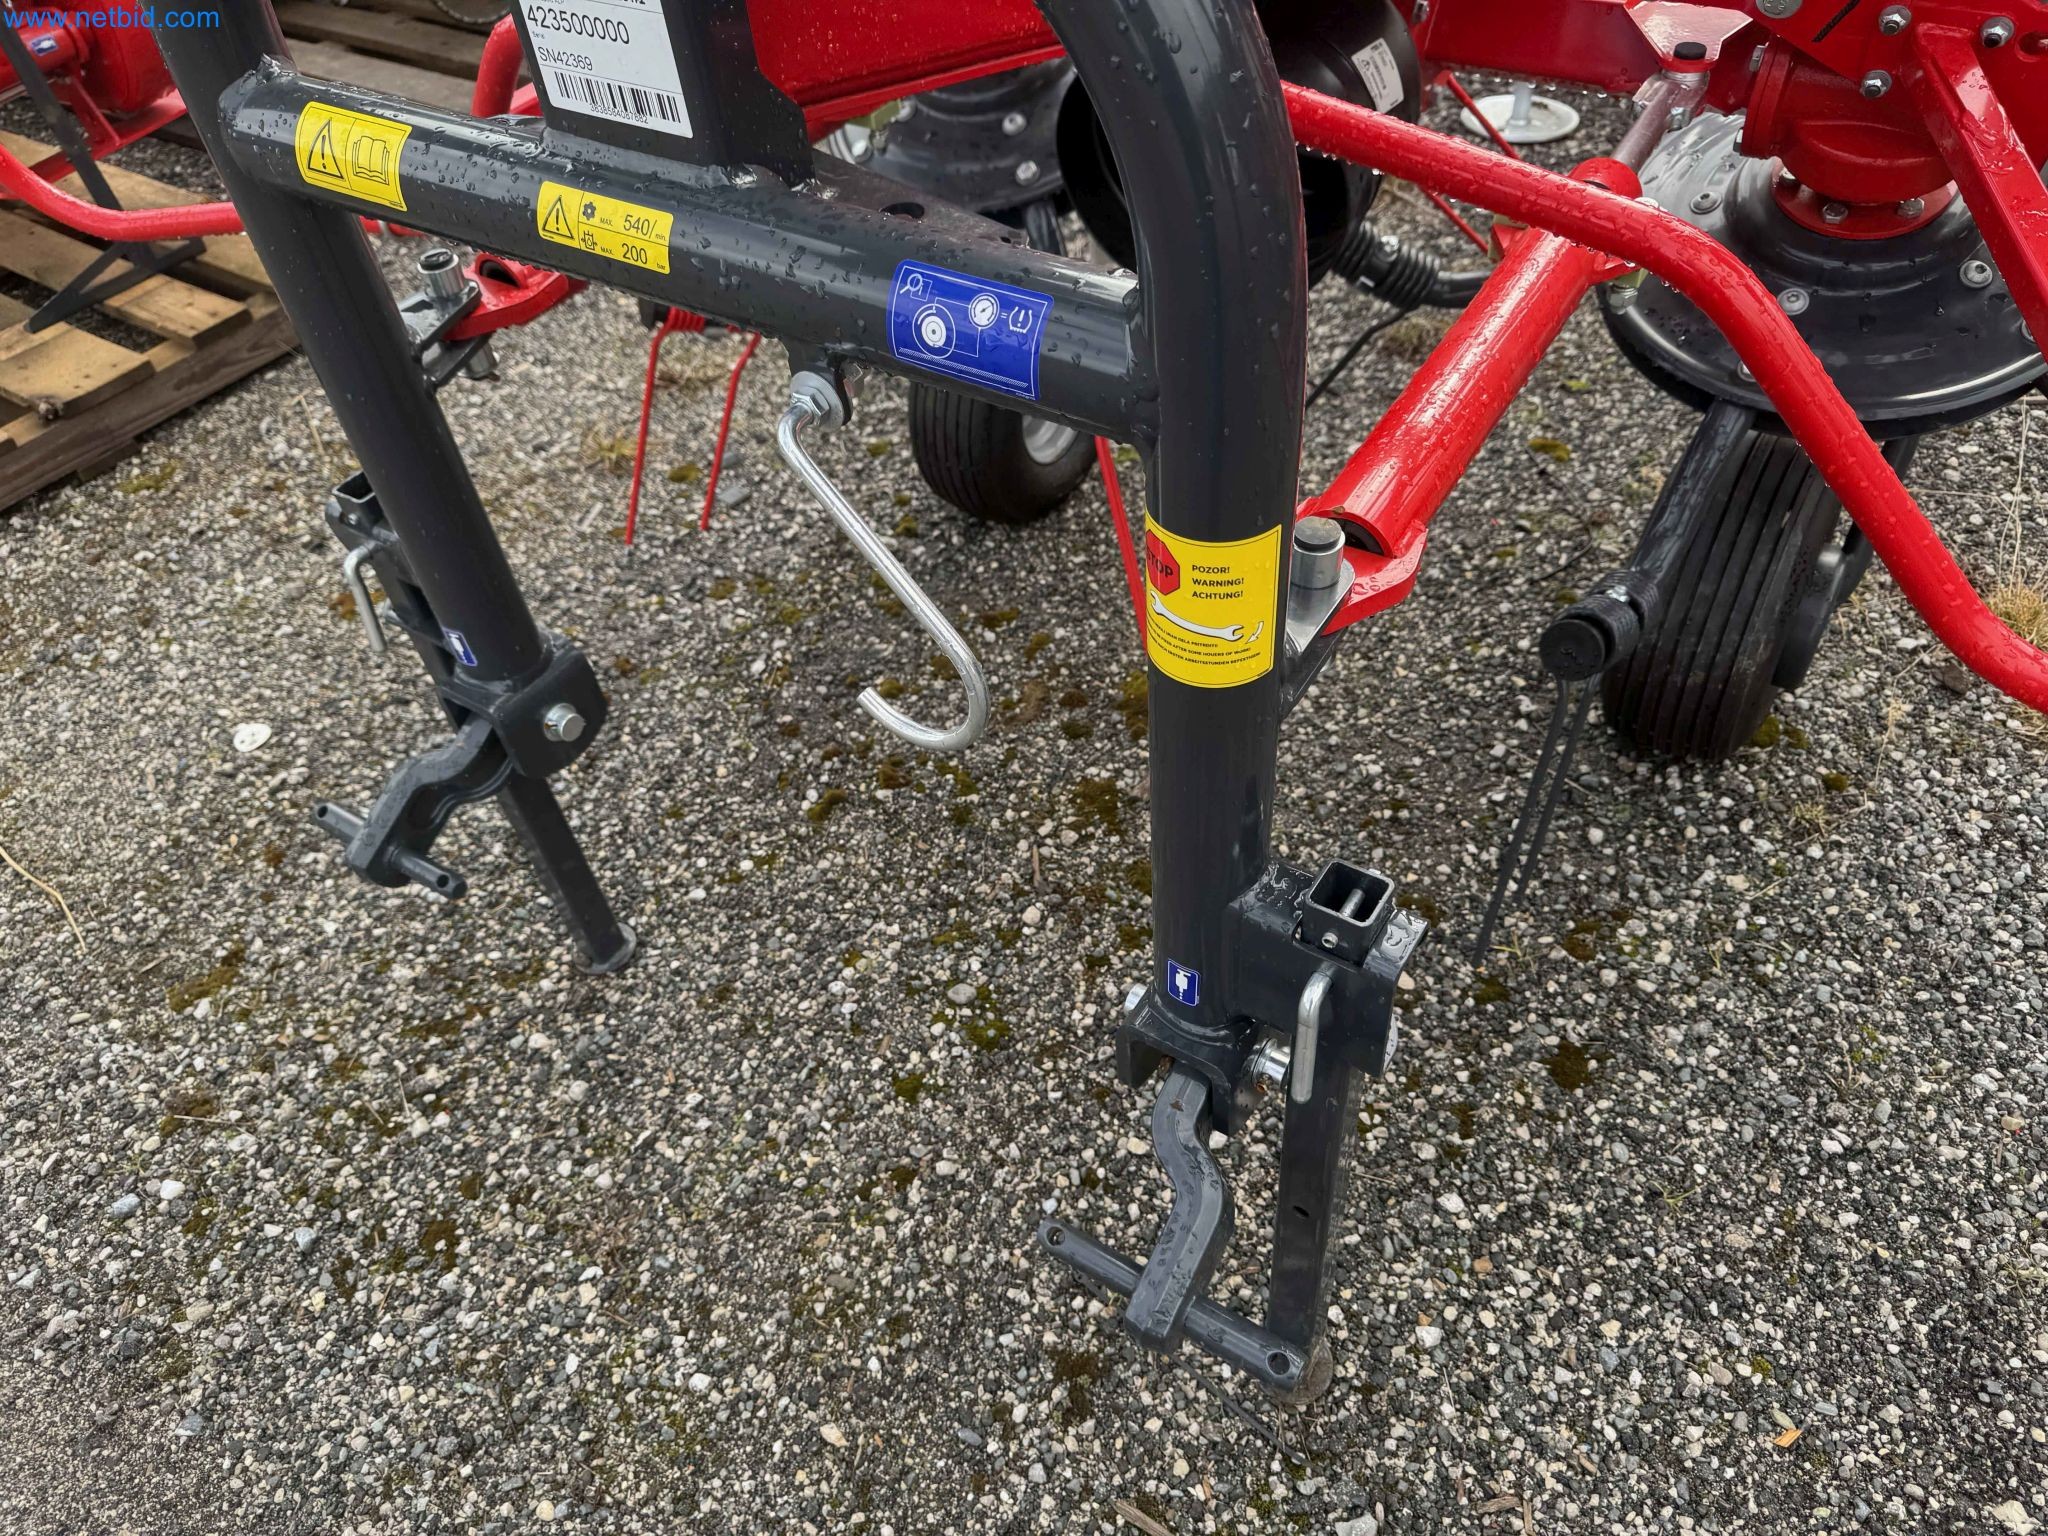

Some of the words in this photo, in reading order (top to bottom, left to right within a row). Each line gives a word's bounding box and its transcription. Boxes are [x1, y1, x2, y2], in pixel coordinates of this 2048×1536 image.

[528, 5, 630, 45] 423500000
[538, 46, 593, 71] SN42369
[621, 243, 648, 265] 200
[1192, 565, 1230, 574] POZOR!
[1191, 577, 1245, 588] WARNING!
[1191, 590, 1244, 600] ACHTUNG!
